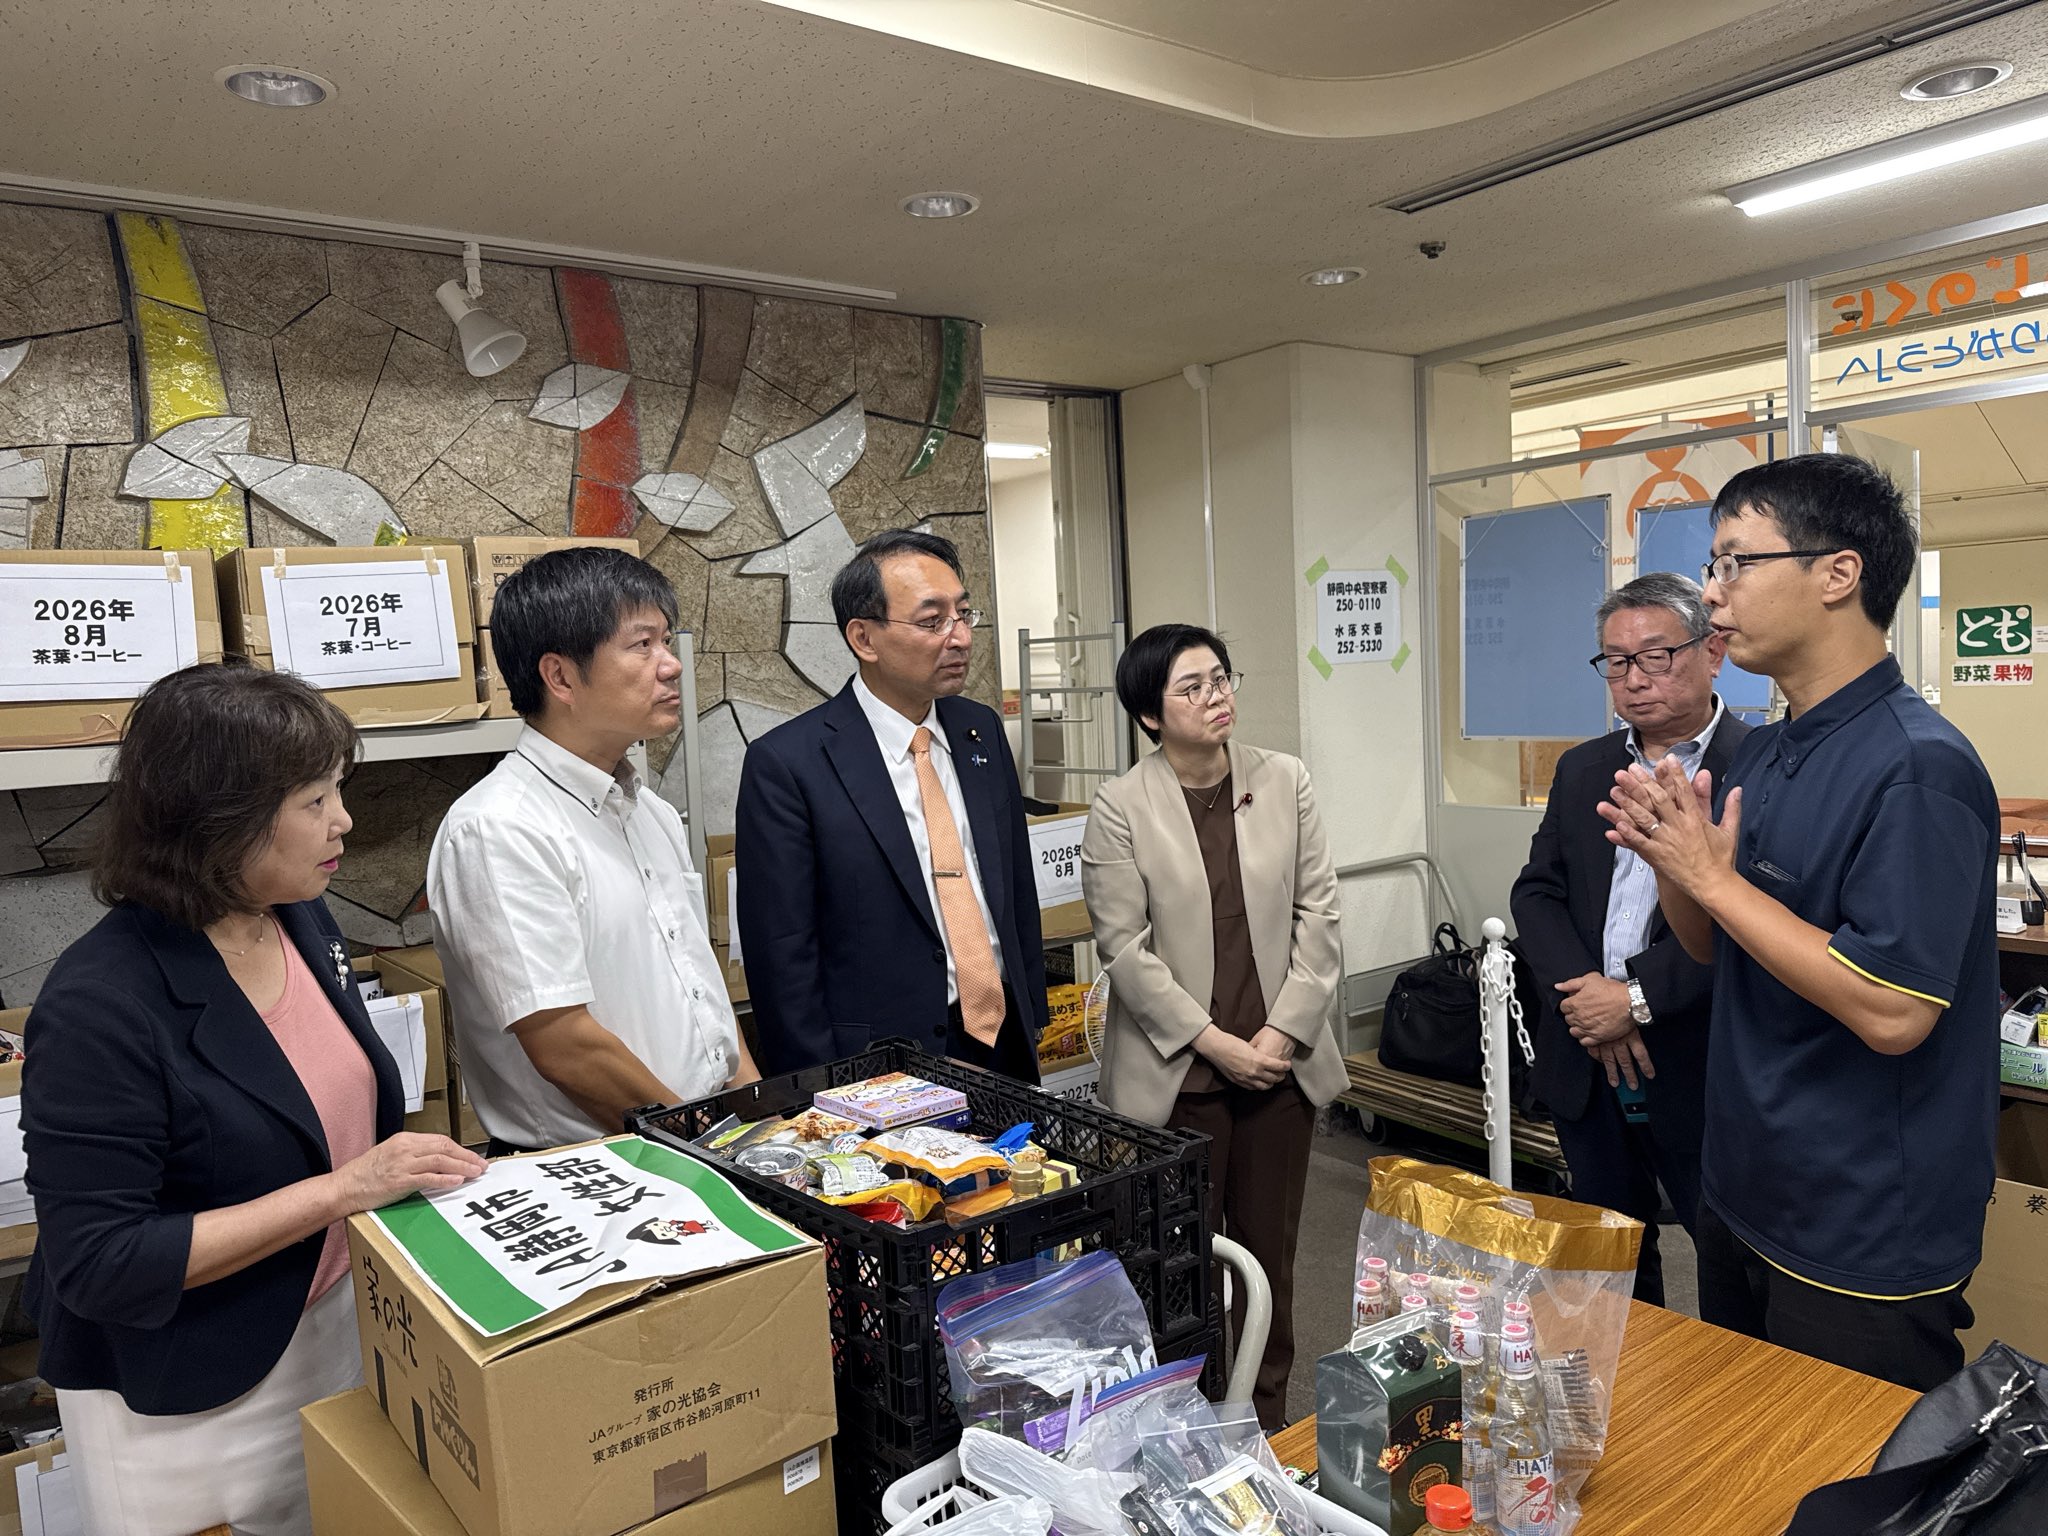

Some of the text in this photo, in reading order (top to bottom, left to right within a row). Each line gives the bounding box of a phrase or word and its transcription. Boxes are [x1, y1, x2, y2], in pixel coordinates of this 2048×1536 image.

[1327, 581, 1387, 596] 静岡中央警察署
[33, 598, 135, 622] 2026年
[319, 592, 403, 616] 2026年
[1336, 598, 1381, 612] 250-0110
[64, 624, 106, 647] 8月
[345, 616, 381, 637] 7月
[1960, 608, 2031, 653] とも
[32, 649, 142, 664] 茶葉・コーヒー
[321, 638, 412, 656] 茶葉・コーヒー
[1337, 639, 1382, 654] 252-5330
[1953, 664, 2033, 682] 野菜果物
[1041, 844, 1082, 865] 2026年
[1055, 861, 1075, 878] 8月
[535, 1157, 666, 1217] 女性部
[463, 1188, 628, 1291] JA静岡市
[362, 1255, 418, 1369] 家の光
[633, 1377, 675, 1405] 発行所
[589, 1382, 722, 1444] JAグループ 家の光協会
[592, 1387, 761, 1466] 東京都新宿区市谷船河原町11
